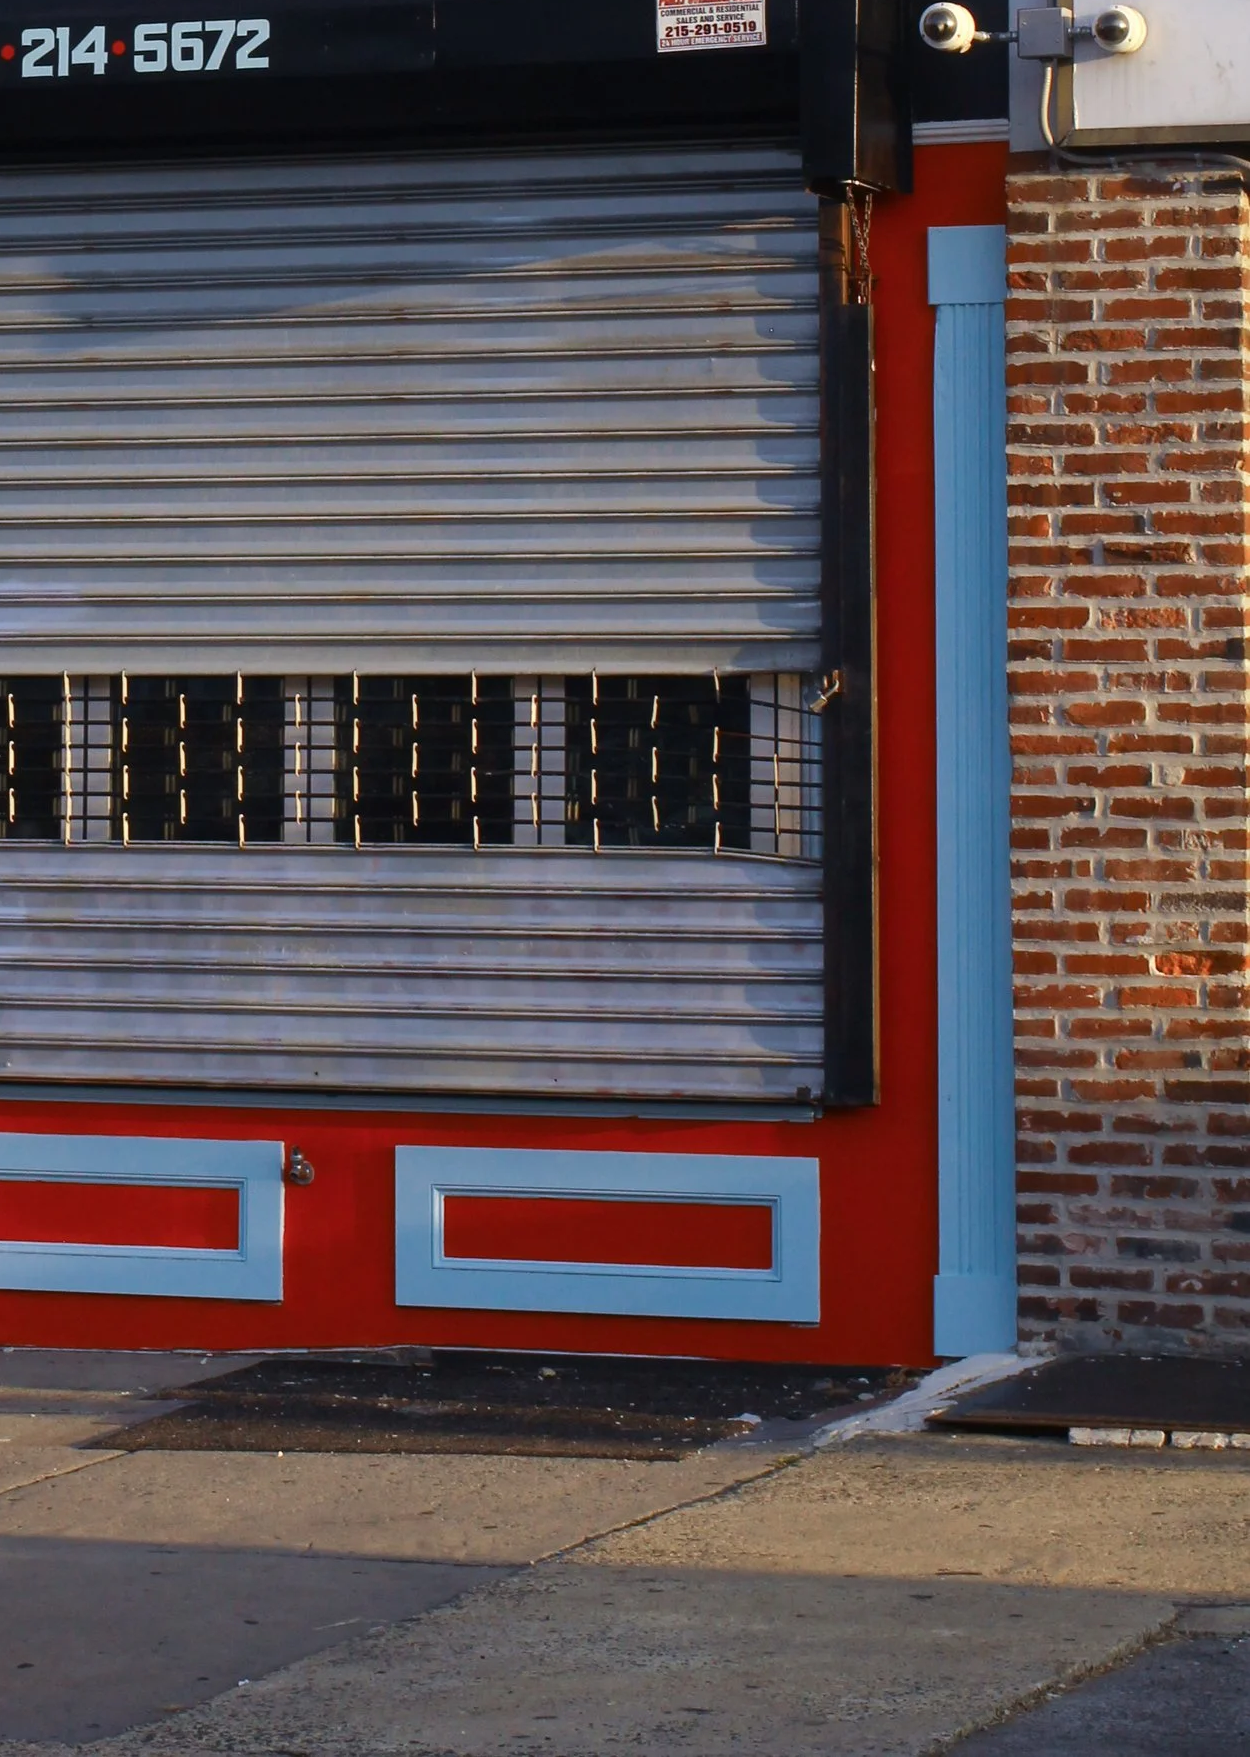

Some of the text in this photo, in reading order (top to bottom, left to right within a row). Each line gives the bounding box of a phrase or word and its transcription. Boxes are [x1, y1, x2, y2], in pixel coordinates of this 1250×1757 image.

[661, 8, 707, 17] COMMERCIAL
[716, 4, 759, 13] RESIDENTIAL
[676, 12, 745, 24] SALES AND SERVICE
[665, 20, 757, 37] 215-291-0519
[732, 32, 761, 42] SERVICE
